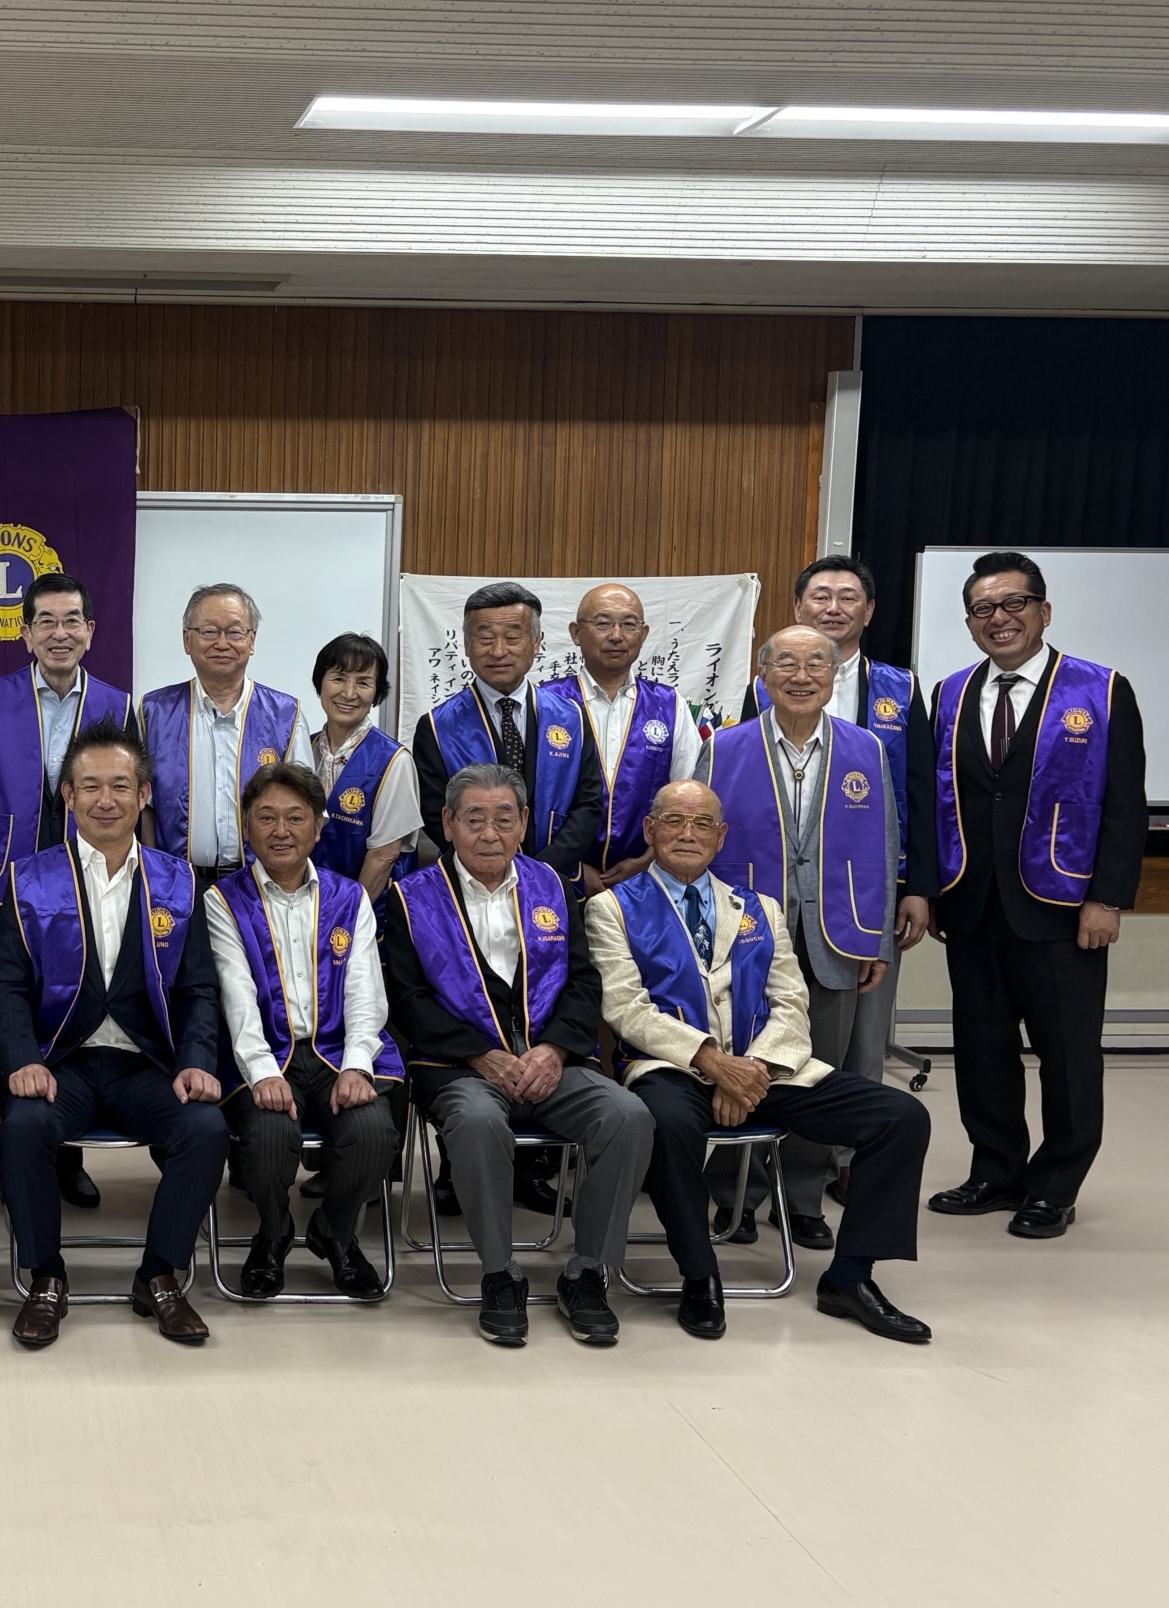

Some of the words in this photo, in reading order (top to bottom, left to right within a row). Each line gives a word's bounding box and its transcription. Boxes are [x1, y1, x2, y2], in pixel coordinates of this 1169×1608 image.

[651, 655, 665, 682] 胸に
[667, 638, 680, 687] うたえラ
[331, 812, 364, 826] K.TACHIKAWA
